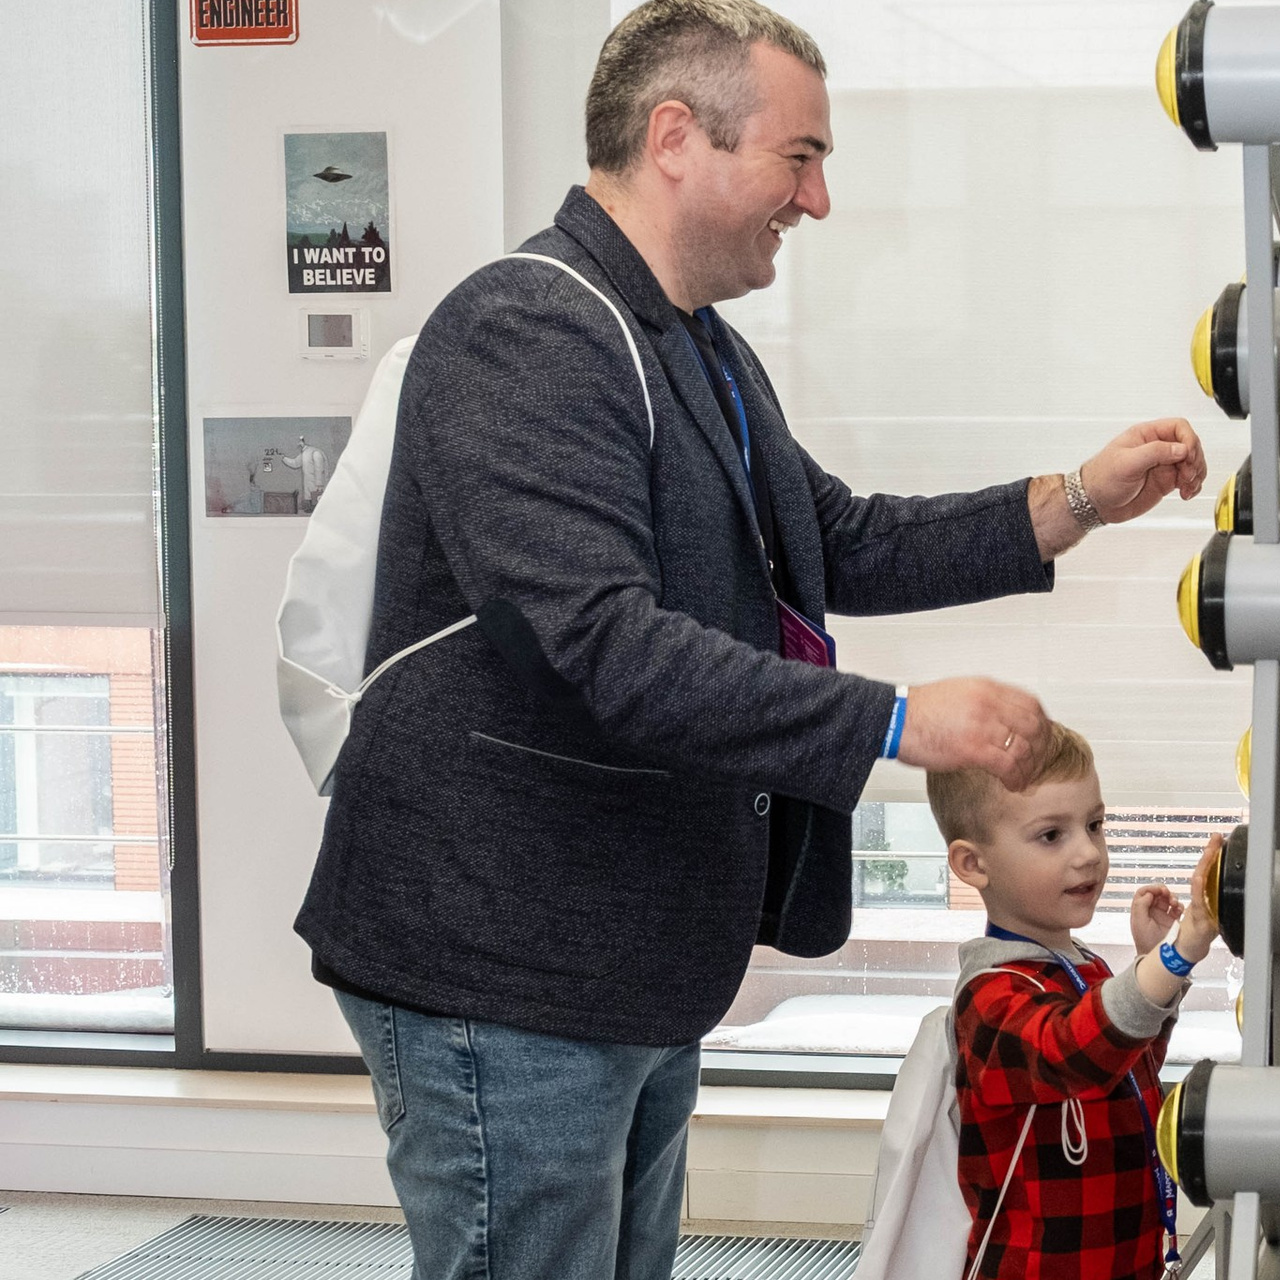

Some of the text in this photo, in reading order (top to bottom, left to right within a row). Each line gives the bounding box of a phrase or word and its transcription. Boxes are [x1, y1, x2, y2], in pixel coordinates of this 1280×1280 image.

[293, 246, 386, 264] I WANT TO
[303, 268, 376, 286] BELIEVE
